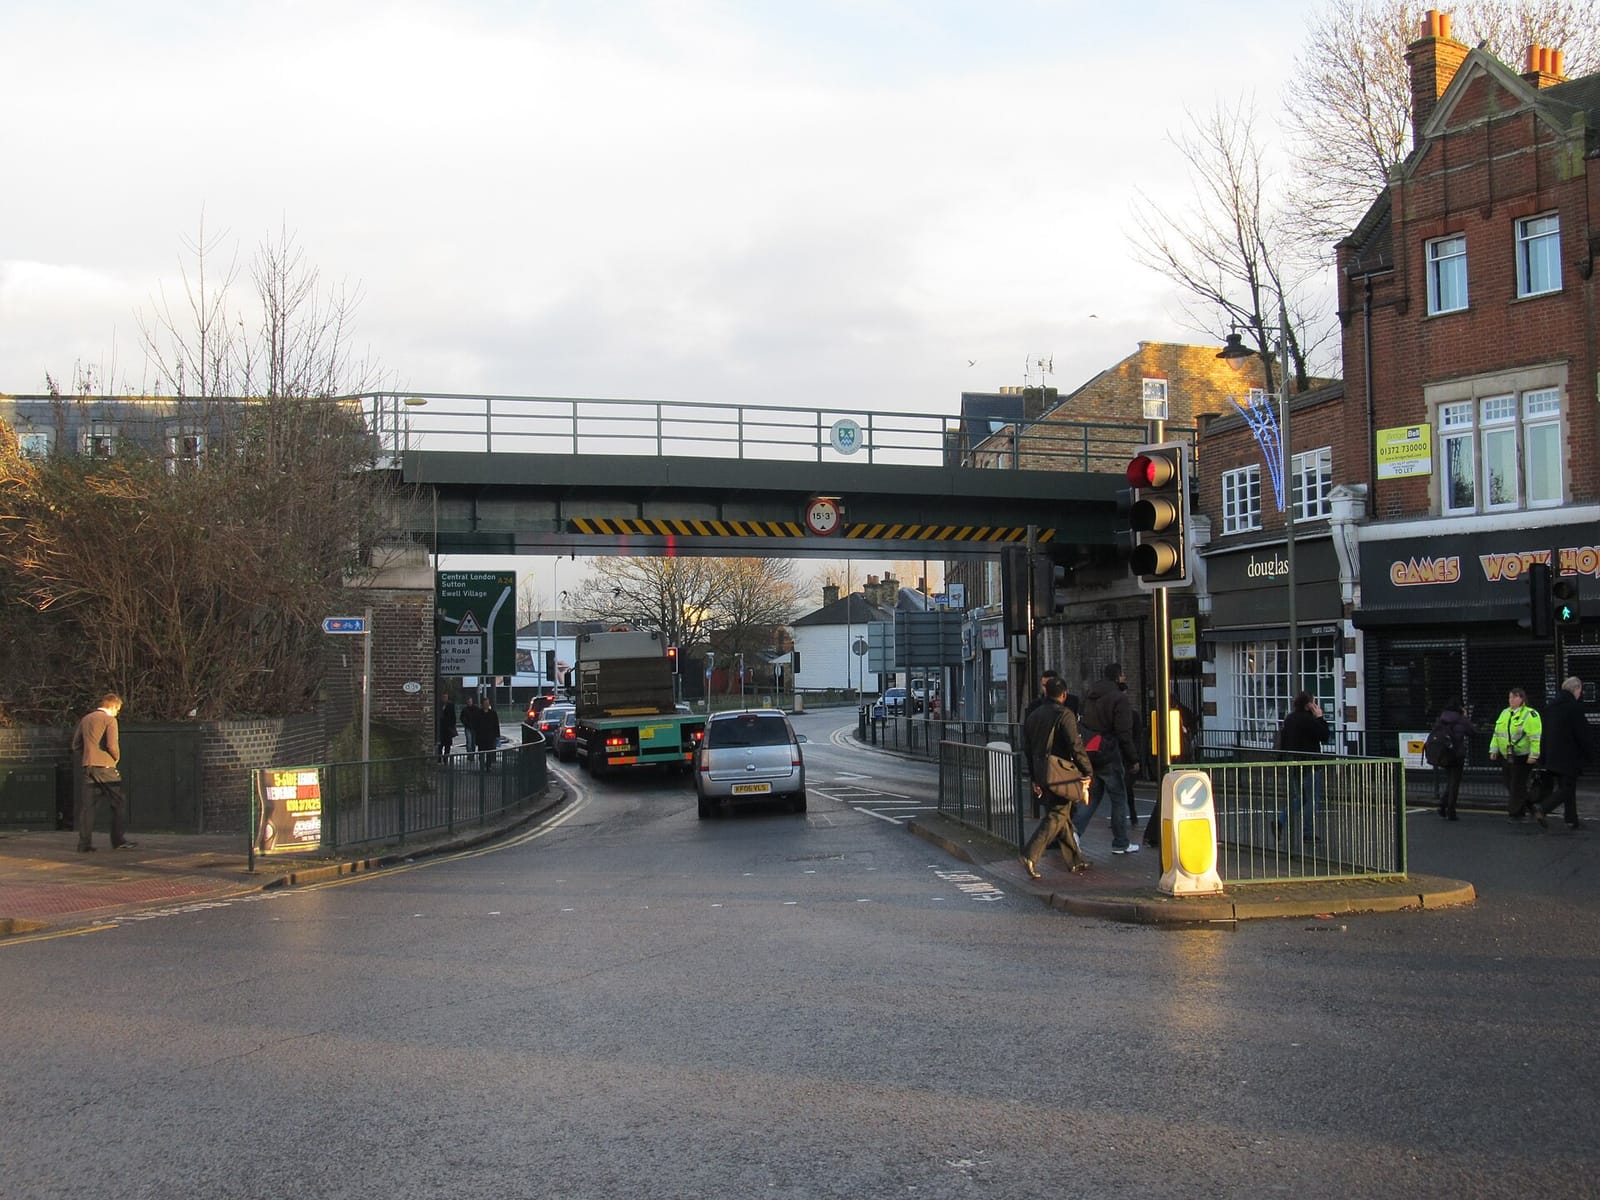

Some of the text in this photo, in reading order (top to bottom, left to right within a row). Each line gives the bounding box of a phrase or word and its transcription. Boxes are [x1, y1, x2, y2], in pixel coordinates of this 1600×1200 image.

[1380, 442, 1427, 456] 01372 730000
[1247, 552, 1289, 578] douglas
[1390, 545, 1600, 587] GAMES WORKHO
[441, 573, 496, 581] Central London
[441, 590, 488, 598] Ewell Village
[452, 647, 471, 655] Road
